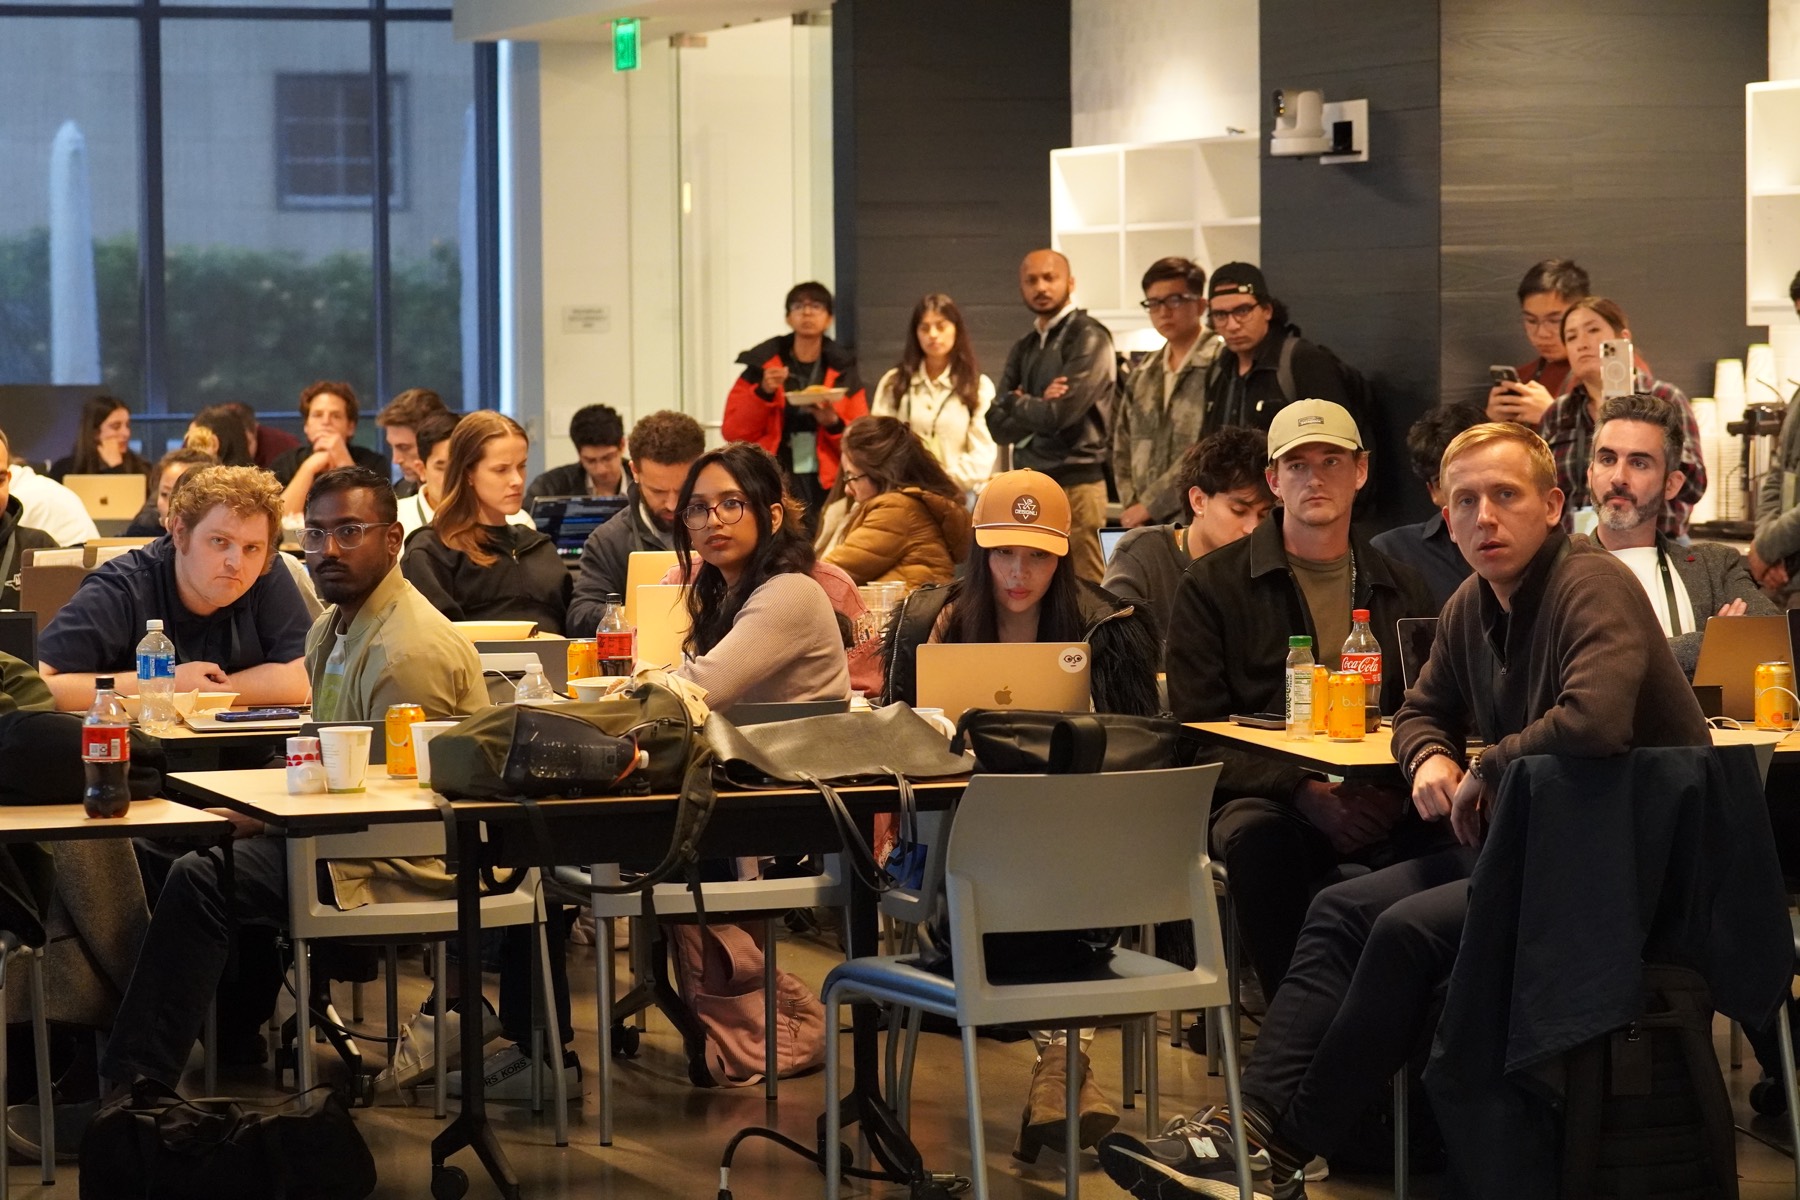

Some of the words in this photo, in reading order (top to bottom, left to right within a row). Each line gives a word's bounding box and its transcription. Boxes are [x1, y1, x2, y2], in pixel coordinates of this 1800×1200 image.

[1341, 656, 1379, 673] Coca-Cola
[484, 1074, 498, 1087] RS
[501, 1058, 527, 1078] KORS
[1188, 1136, 1219, 1158] N
